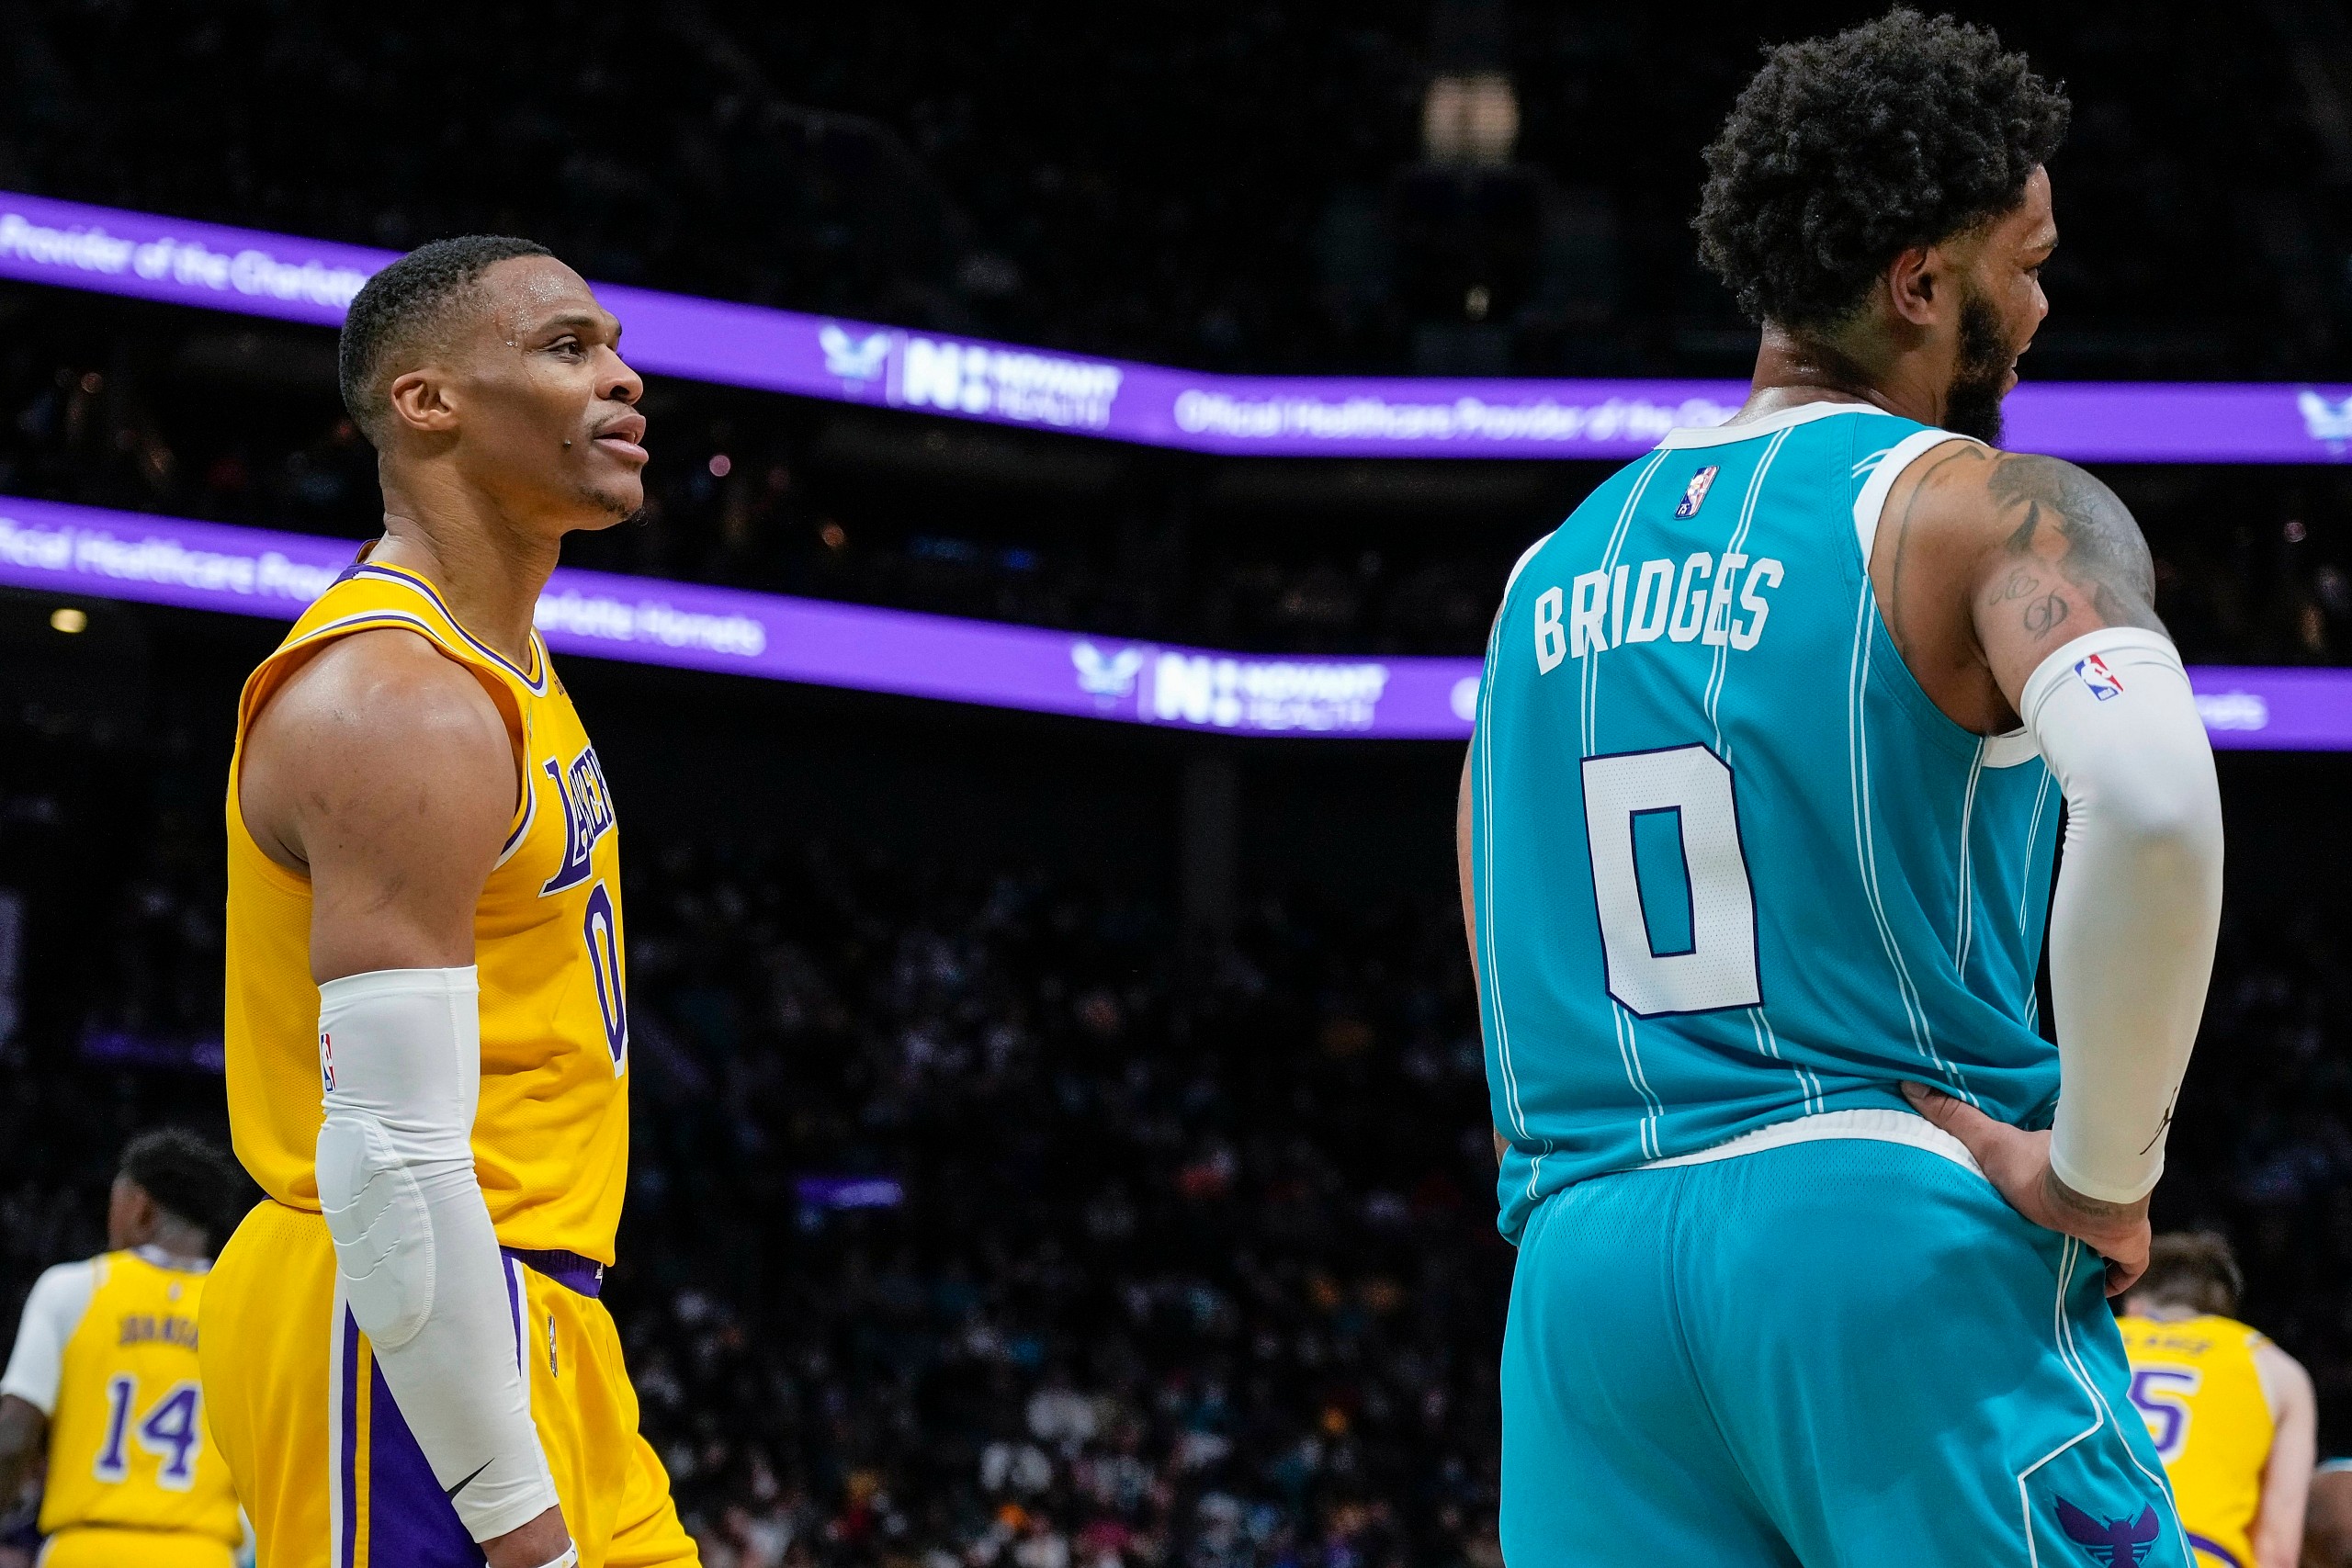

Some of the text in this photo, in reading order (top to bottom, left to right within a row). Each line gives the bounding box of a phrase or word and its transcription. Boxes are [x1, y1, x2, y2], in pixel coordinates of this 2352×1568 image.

[1533, 551, 1785, 676] BRIDGES
[1579, 740, 1765, 1021] 0
[582, 877, 628, 1080] 0
[94, 1372, 204, 1492] 14
